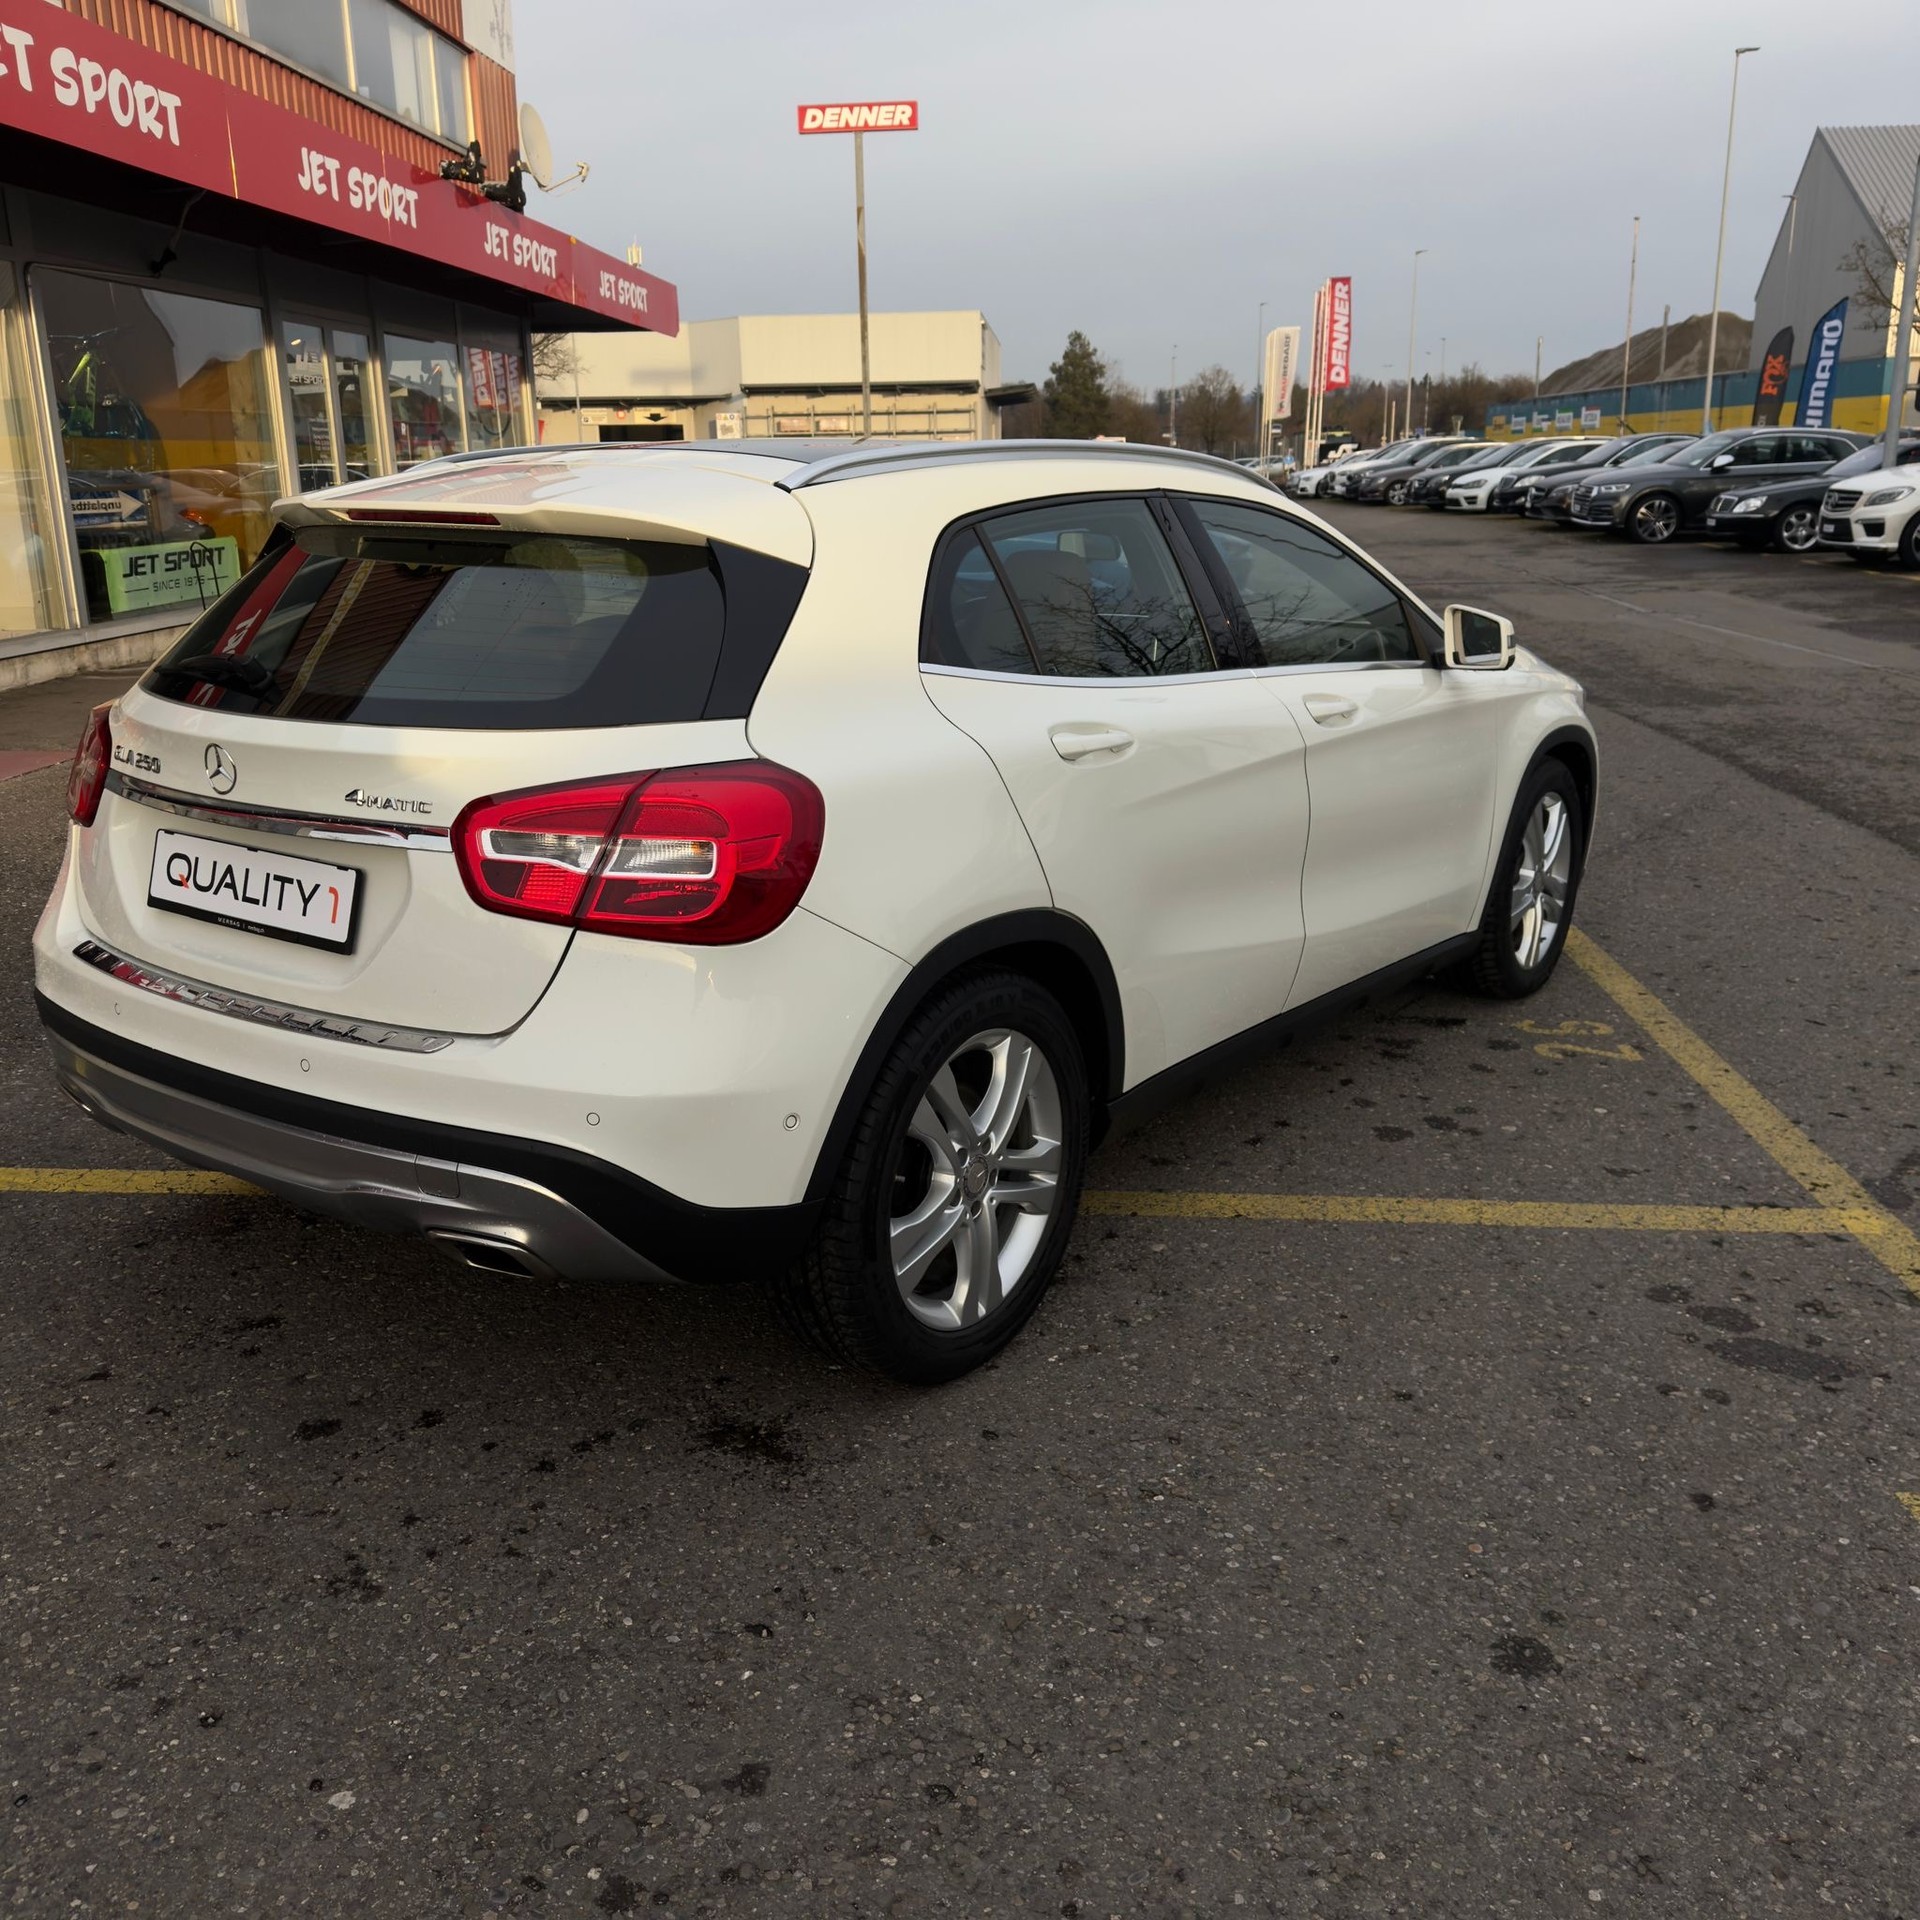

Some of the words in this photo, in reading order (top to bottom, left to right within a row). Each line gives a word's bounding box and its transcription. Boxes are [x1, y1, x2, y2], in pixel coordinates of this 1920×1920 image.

[0, 22, 35, 92] T
[50, 47, 182, 146] SPORT
[802, 104, 913, 129] DENNER
[298, 146, 341, 202] JET
[347, 166, 419, 229] SPORT
[484, 221, 509, 262] JET
[513, 233, 557, 279] SPORT
[600, 270, 616, 301] JET
[618, 278, 648, 313] SPORT
[1330, 281, 1350, 384] DENNER
[1761, 354, 1789, 395] FOX
[1805, 318, 1843, 429] HIMANO
[122, 554, 159, 578] JET
[164, 547, 225, 572] SPORT
[153, 578, 180, 592] SINCE
[135, 752, 161, 774] 250
[345, 789, 433, 814] 4MATIC
[166, 852, 321, 917] QUALITY
[328, 886, 340, 924] 1
